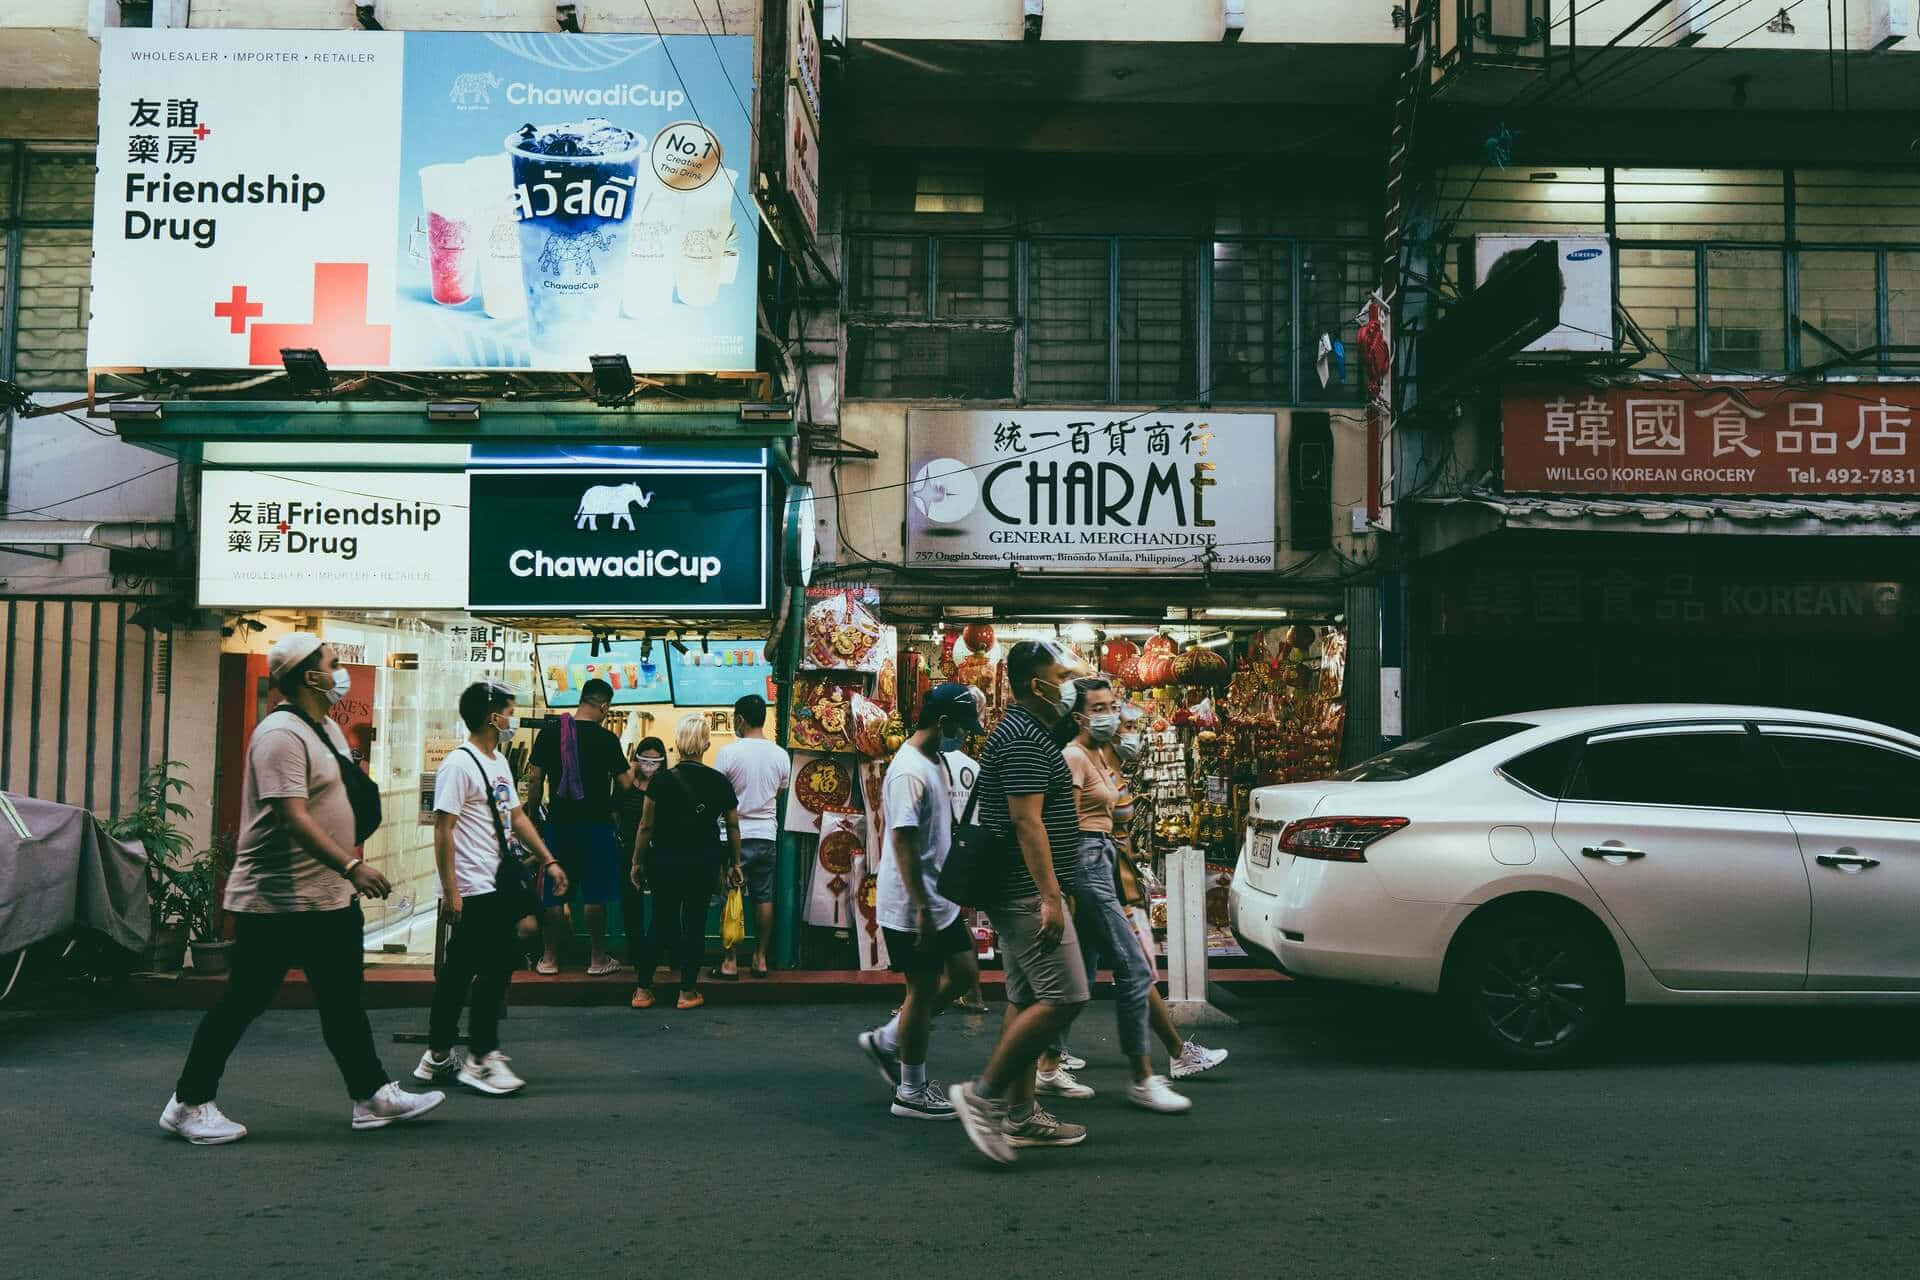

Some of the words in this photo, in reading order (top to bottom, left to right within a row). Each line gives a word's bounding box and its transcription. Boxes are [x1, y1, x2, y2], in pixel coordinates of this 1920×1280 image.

[131, 51, 218, 62] WHOLESALER
[233, 52, 299, 63] IMPORTER
[313, 53, 375, 63] RETAILER
[506, 82, 685, 111] ChawadiCup
[129, 98, 198, 128] 友誼
[127, 135, 197, 164] 藥房
[666, 133, 712, 159] No.1
[660, 163, 679, 175] Thai
[125, 173, 326, 212] Friendship
[125, 210, 217, 248] Drug
[543, 280, 600, 290] ChawadiCup
[993, 421, 1217, 457] 統一百貨商行
[1543, 395, 1913, 458] 韓國食品店
[1545, 467, 1608, 482] WILLGO
[1611, 467, 1678, 482] KOREAN
[1680, 468, 1756, 483] GROCERY
[1787, 467, 1822, 484] Tel.
[1825, 467, 1916, 484] 492-7831
[981, 461, 1218, 527] CHARME
[228, 501, 282, 525] 友誼
[287, 501, 441, 531] Friendship
[228, 530, 281, 553] 藥房
[287, 531, 358, 560] Drug
[989, 530, 1078, 545] GENERAL
[1080, 531, 1217, 546] MERCHANDISE
[509, 549, 722, 584] ChawadiCup
[915, 552, 933, 561] 757
[935, 552, 970, 563] Ongpin
[972, 552, 1000, 562] Street,
[1002, 552, 1055, 562] Chinatown,
[1057, 553, 1096, 562] Binondo
[1098, 553, 1133, 563] Manila,
[1135, 553, 1186, 565] Philippines
[1228, 555, 1272, 564] 244-0369
